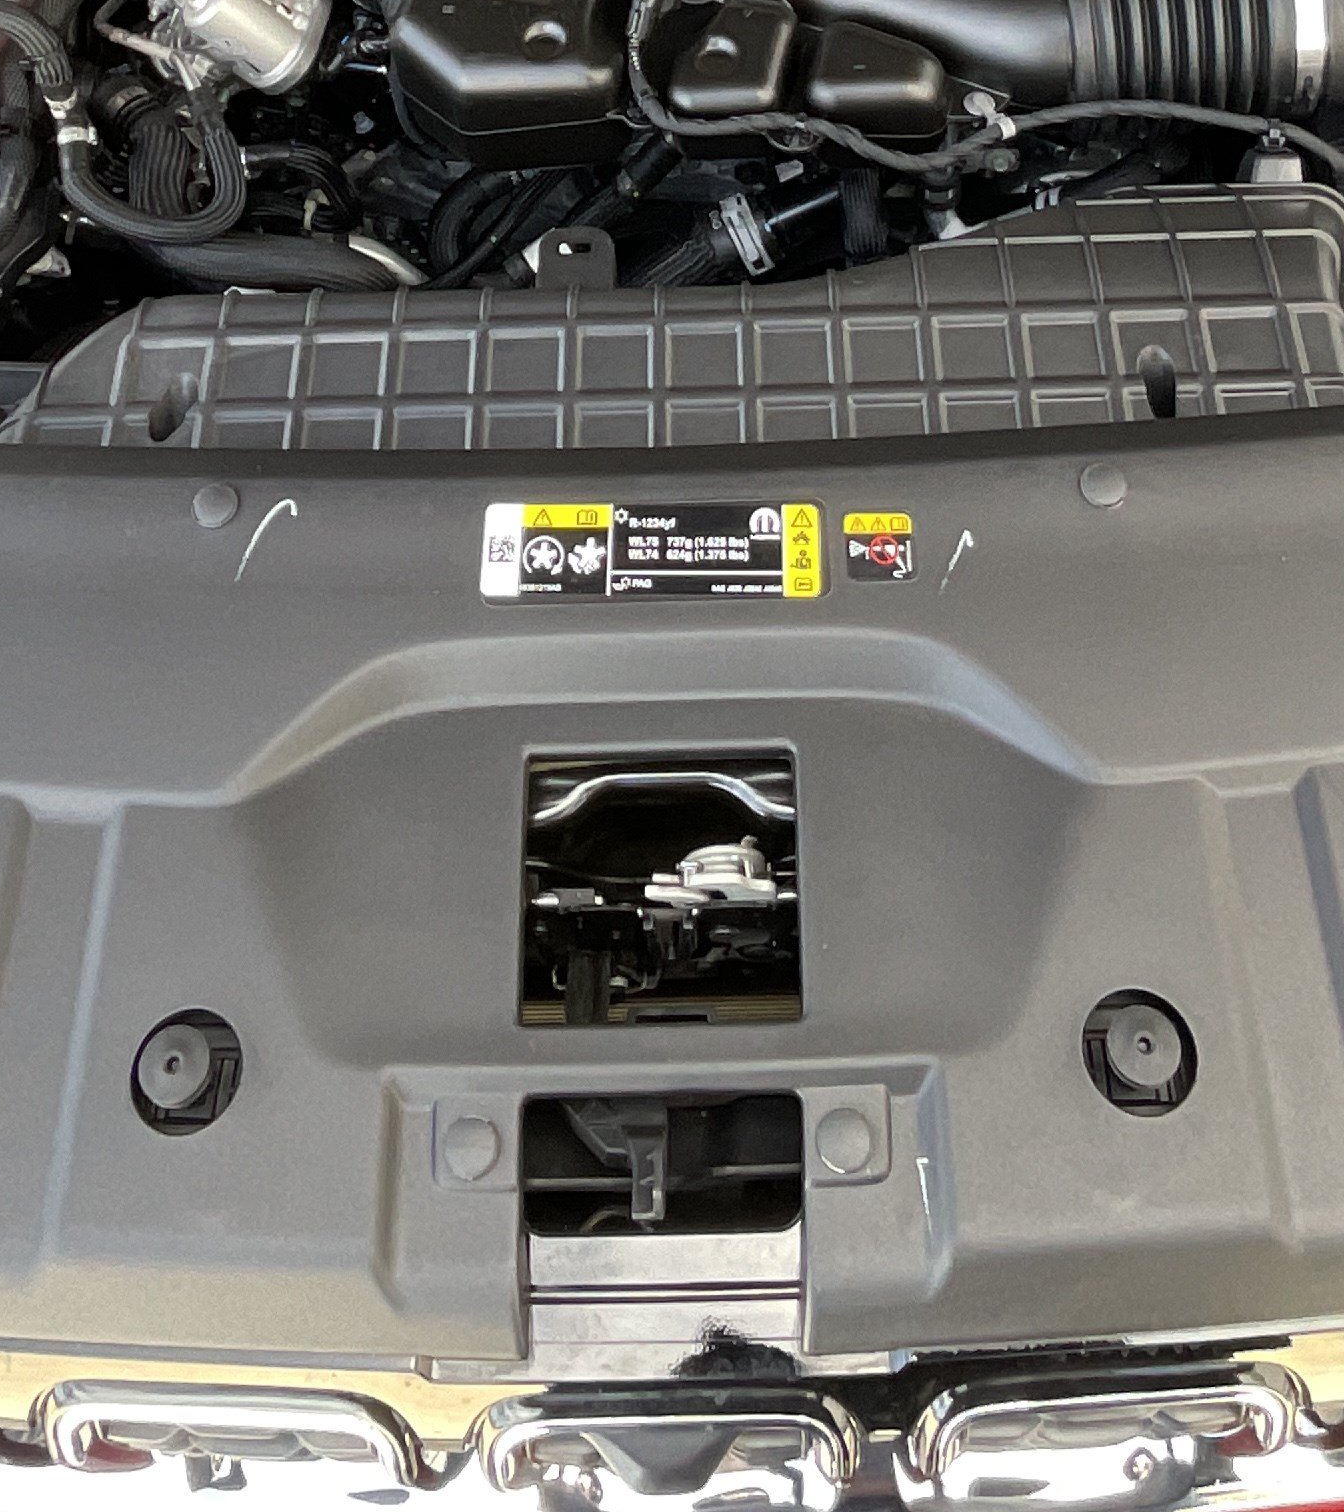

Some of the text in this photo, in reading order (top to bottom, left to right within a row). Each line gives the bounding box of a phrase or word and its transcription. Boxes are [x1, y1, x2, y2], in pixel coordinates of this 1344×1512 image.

[629, 517, 676, 530] R-1234yf
[628, 536, 659, 548] WL75
[667, 536, 693, 549] 737g
[628, 548, 659, 560] WL74
[666, 549, 693, 562] 624g
